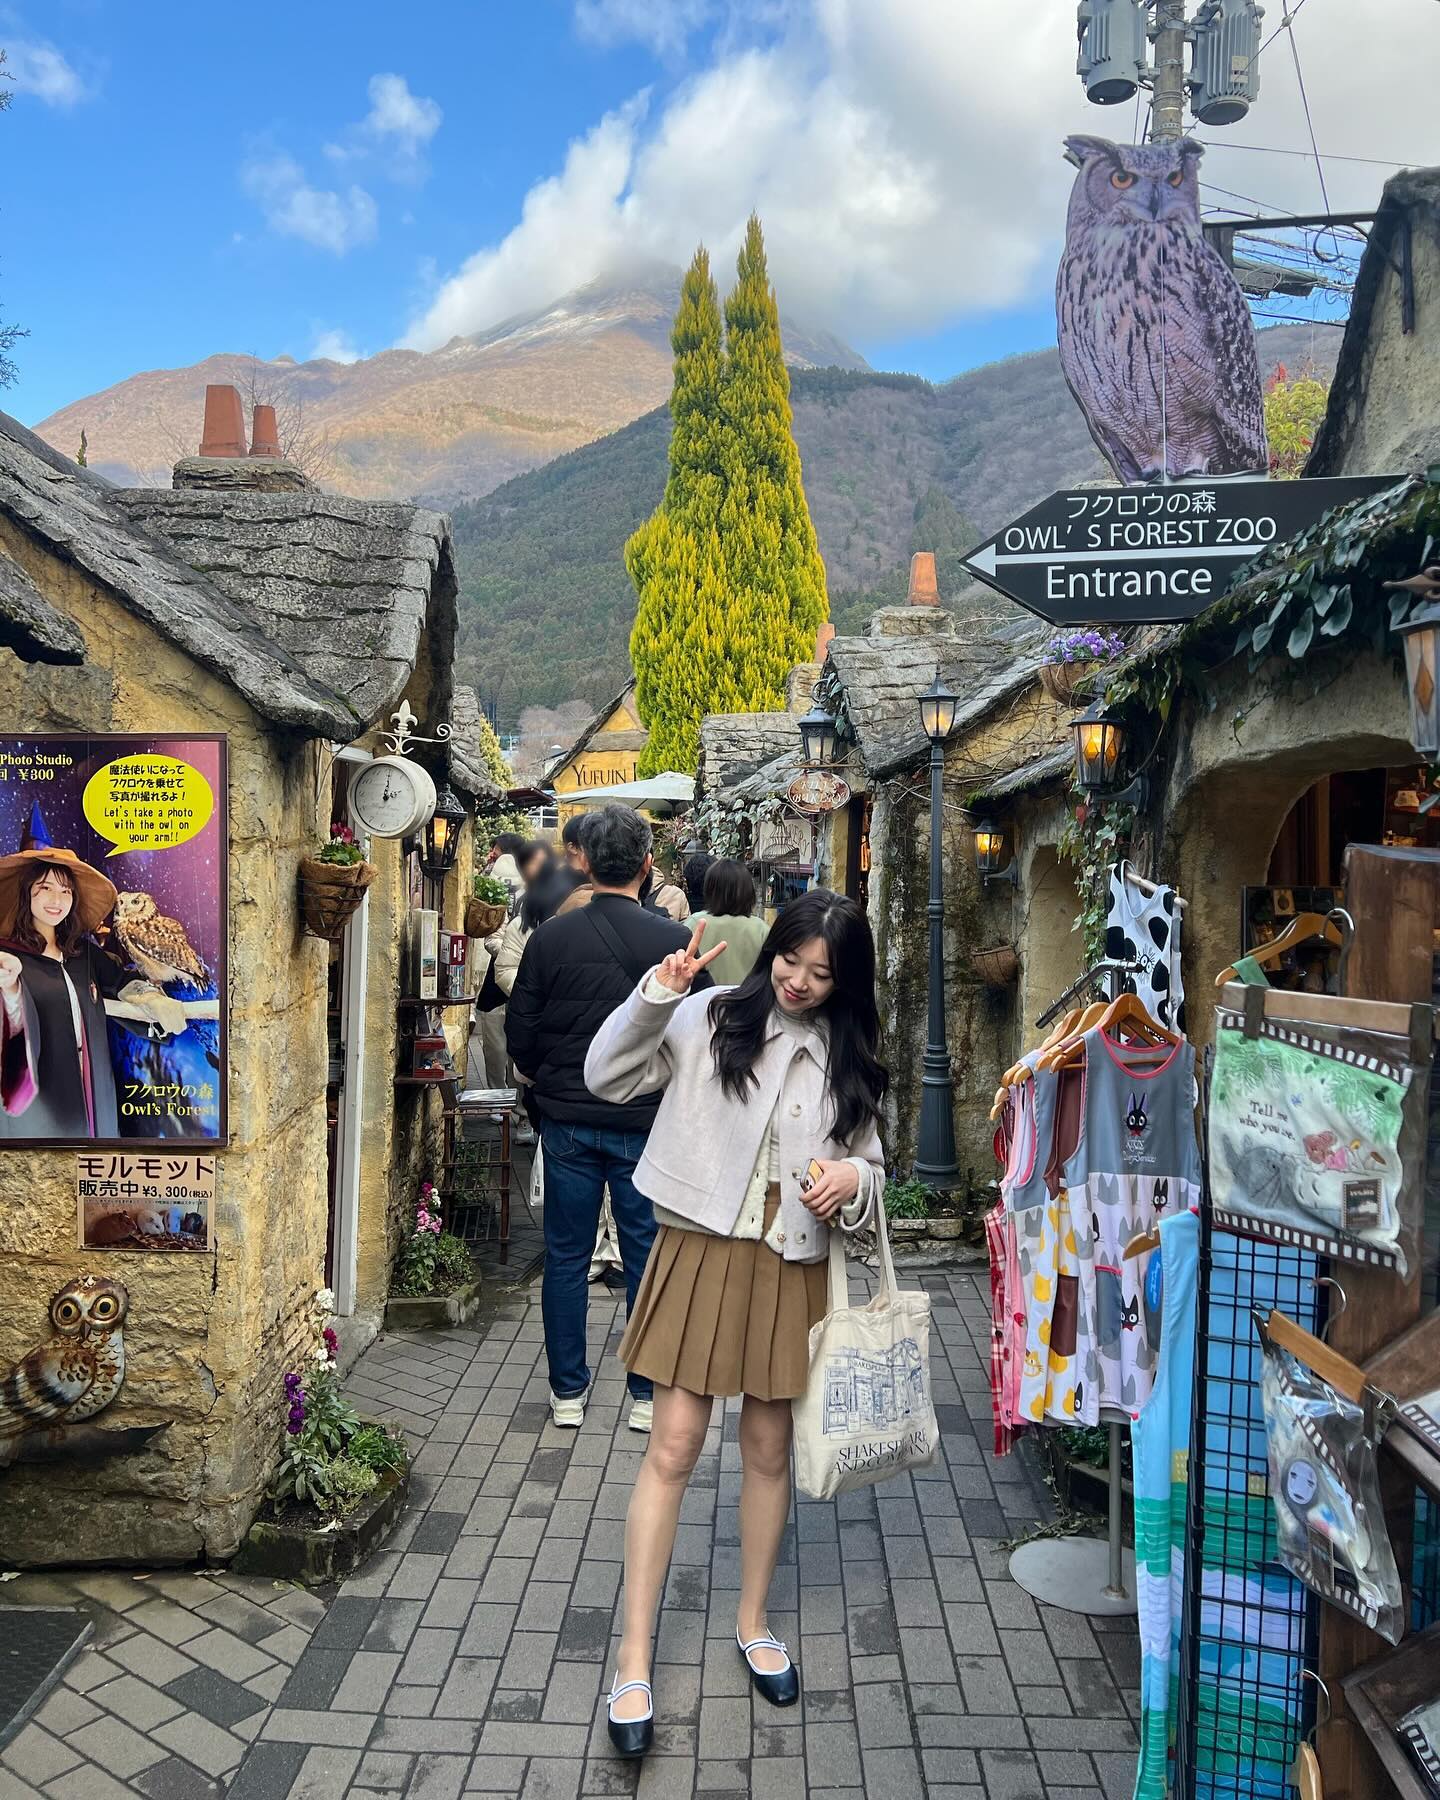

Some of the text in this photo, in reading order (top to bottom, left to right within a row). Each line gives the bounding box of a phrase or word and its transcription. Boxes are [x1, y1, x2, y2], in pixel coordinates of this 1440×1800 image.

[1066, 489, 1217, 519] フクロウの森
[1110, 519, 1209, 548] FOREST
[1216, 516, 1277, 543] ZOO
[1047, 564, 1213, 600] Entrance
[0, 753, 73, 766] Photo Studio
[109, 764, 185, 775] 魔法使いになって
[109, 777, 185, 788] フクロウを乗せて
[104, 805, 129, 817] Let's
[134, 807, 153, 817] take
[167, 807, 193, 818] photo
[114, 819, 189, 830] with the owl on
[129, 832, 179, 843] your arm!!
[124, 1083, 214, 1100] フクロウの森
[121, 1102, 216, 1116] Owl's Forest
[1249, 1099, 1273, 1118] Tell
[78, 1156, 214, 1181] モルモット
[78, 1179, 139, 1198] 販売中
